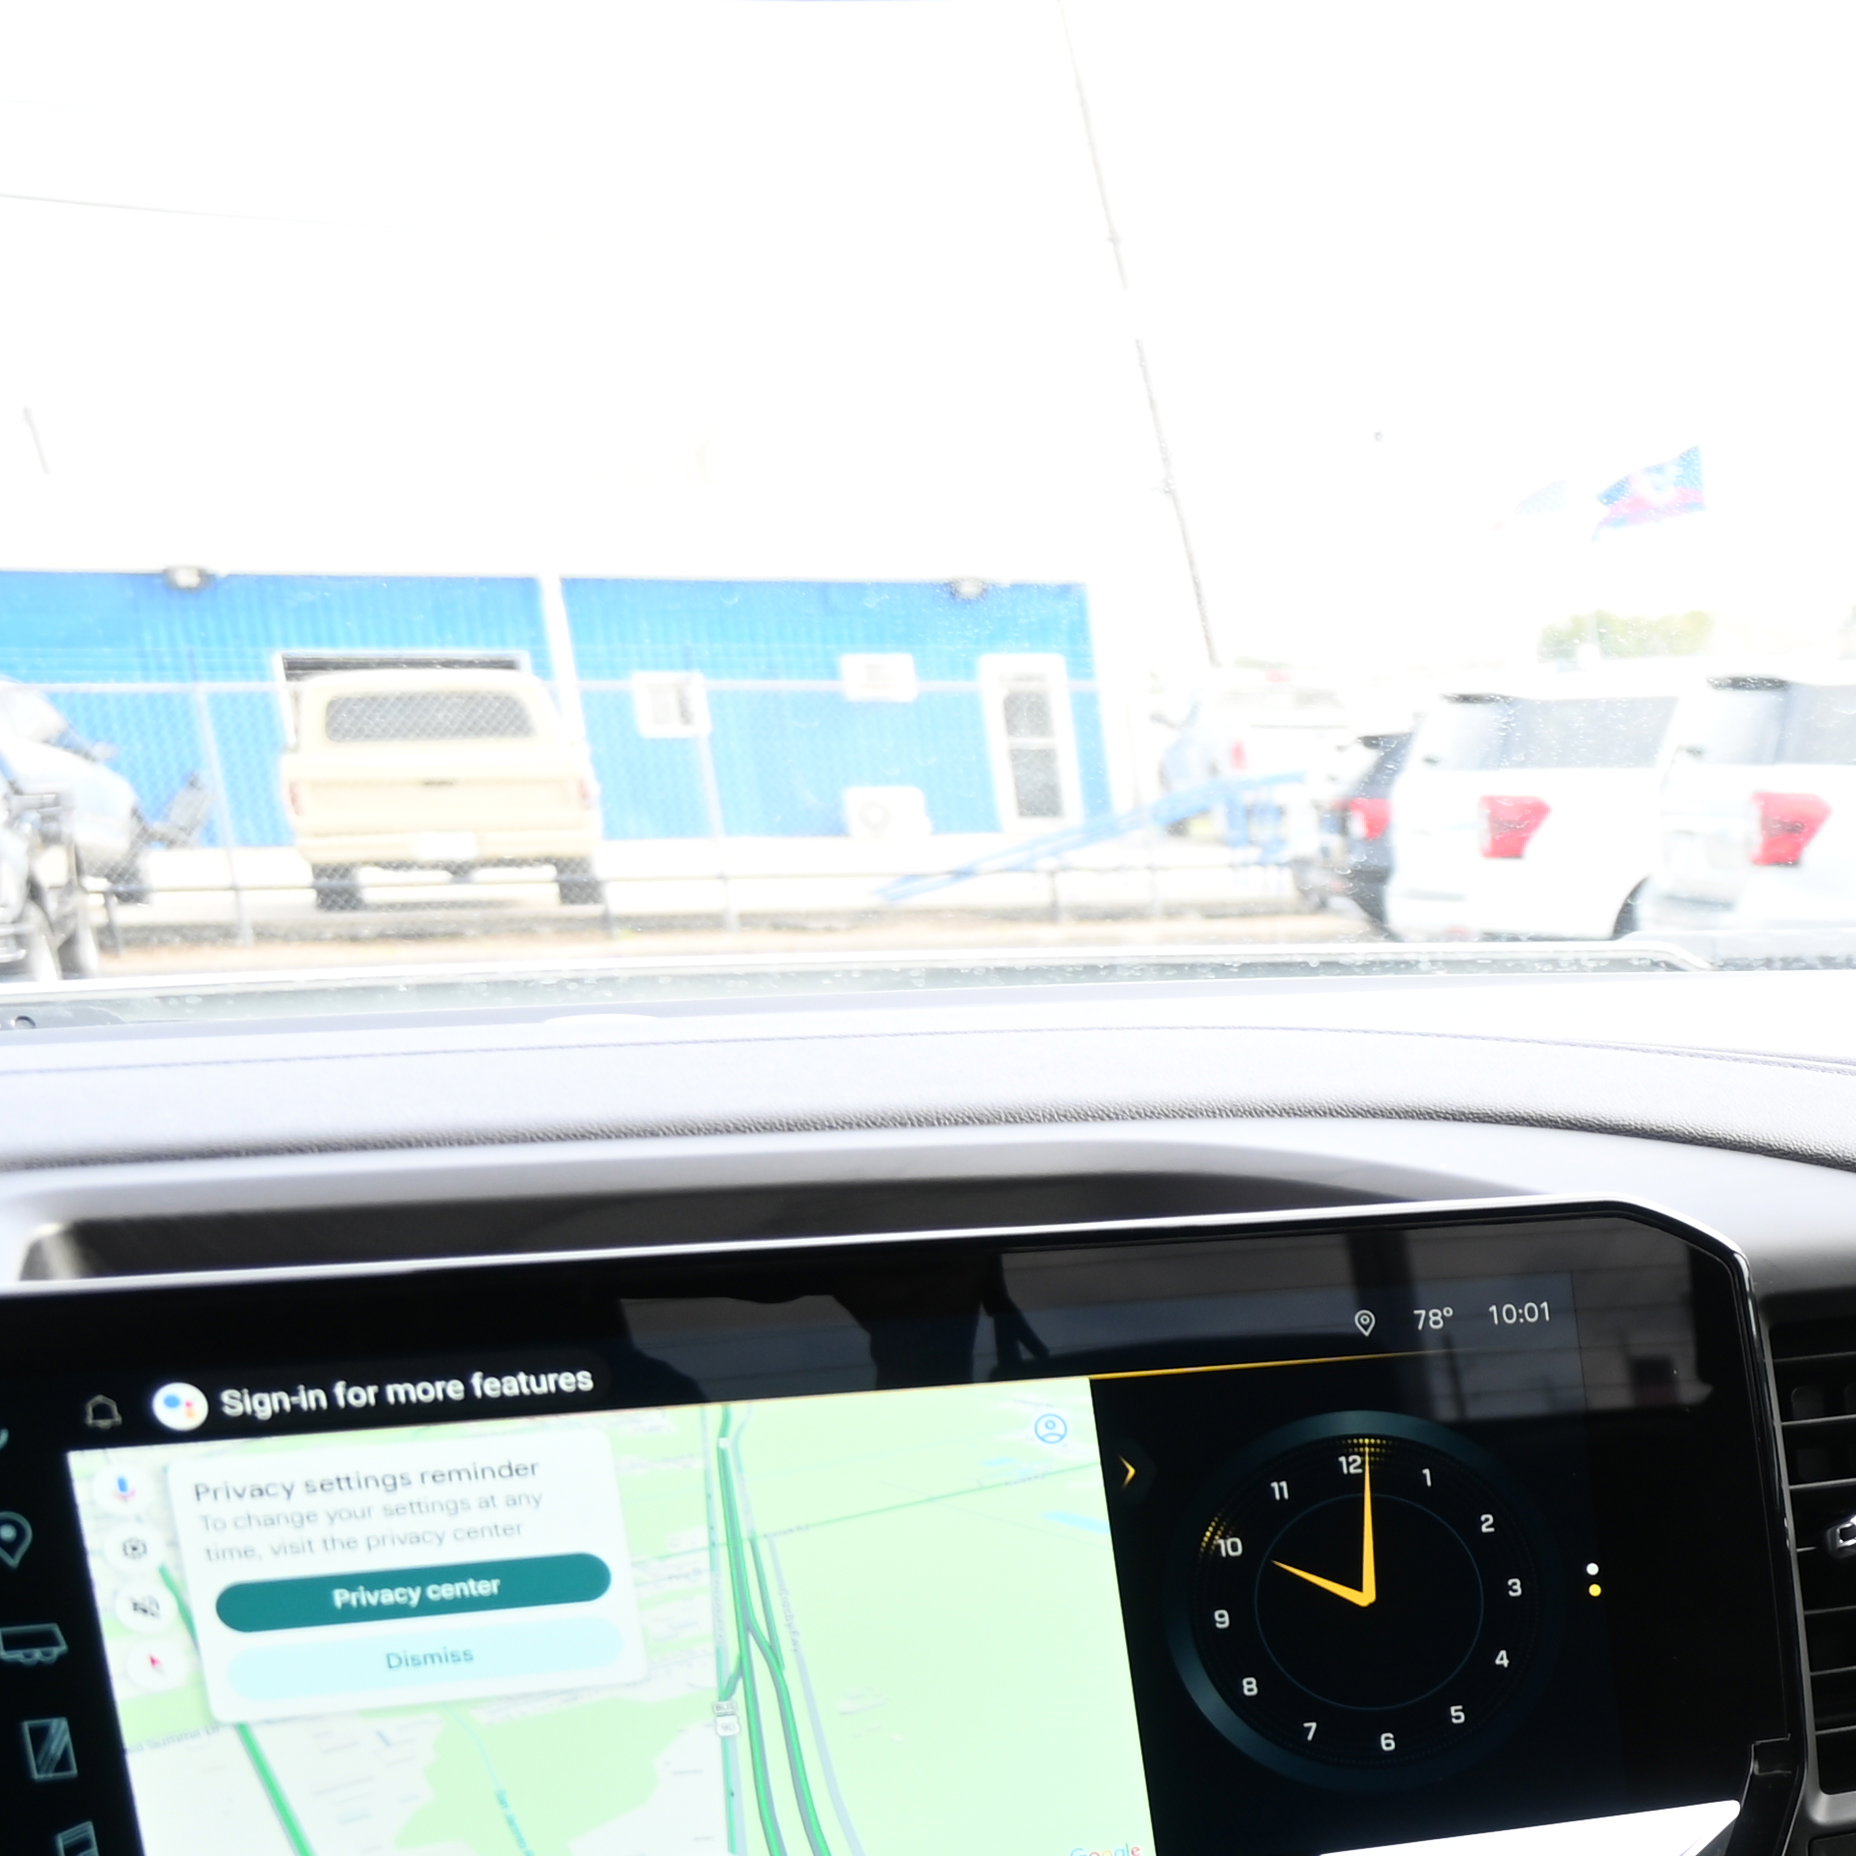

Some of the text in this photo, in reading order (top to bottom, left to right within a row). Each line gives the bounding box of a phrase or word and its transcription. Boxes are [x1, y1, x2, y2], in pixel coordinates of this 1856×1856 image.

[1488, 1301, 1551, 1326] 10:01
[220, 1367, 594, 1421] Sign-in for more features
[1338, 1454, 1363, 1475] 12
[193, 1459, 540, 1502] Privacy settings reminder
[1422, 1468, 1432, 1487] 1
[1270, 1480, 1289, 1501] 11
[199, 1493, 544, 1532] To change your settings at any
[1480, 1513, 1495, 1533] 2
[269, 1538, 314, 1557] visit
[322, 1534, 359, 1552] the
[366, 1528, 447, 1550] privacy
[453, 1521, 524, 1542] center
[1219, 1536, 1243, 1558] 10
[332, 1577, 501, 1609] Privacy center
[1507, 1578, 1522, 1597] 3
[1214, 1609, 1230, 1629] 9
[385, 1647, 475, 1670] Dismiss
[1494, 1649, 1510, 1668] 4
[1242, 1677, 1258, 1696] 8
[1450, 1705, 1466, 1724] 5
[1303, 1721, 1318, 1741] 7
[1380, 1732, 1396, 1752] 6
